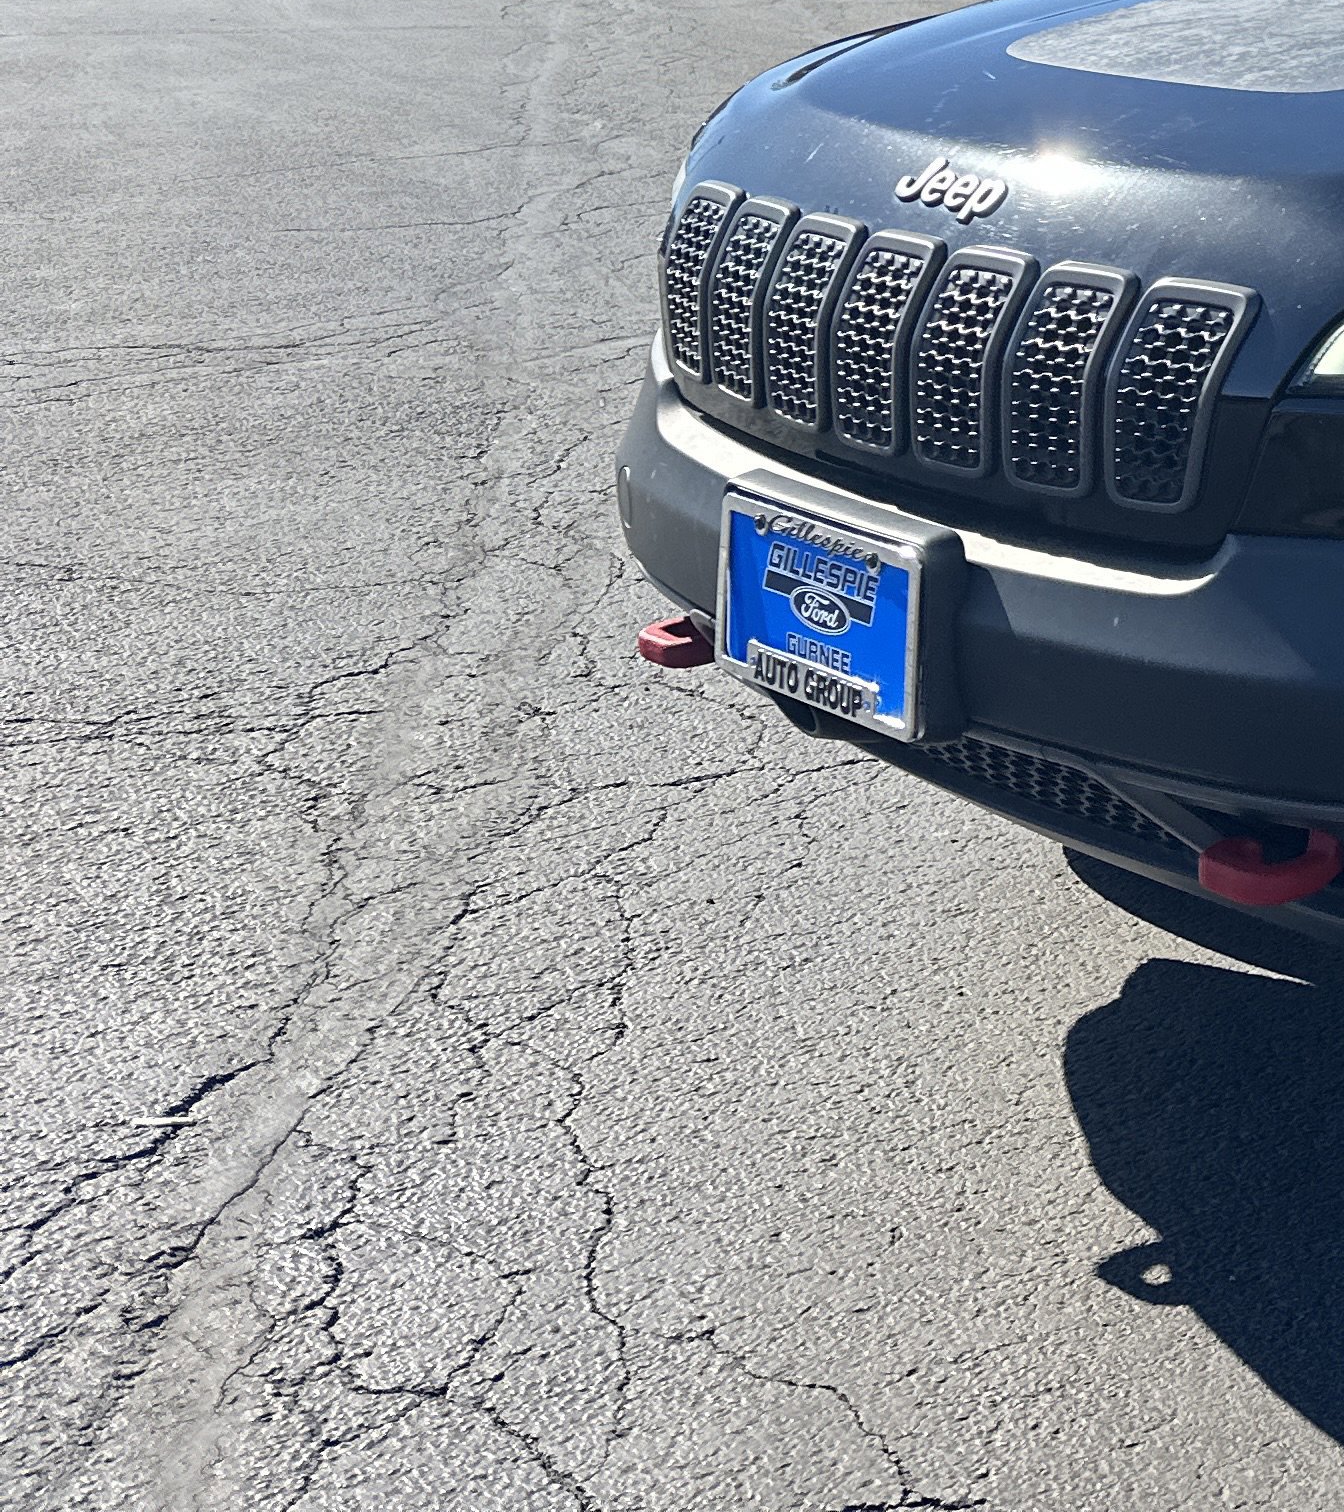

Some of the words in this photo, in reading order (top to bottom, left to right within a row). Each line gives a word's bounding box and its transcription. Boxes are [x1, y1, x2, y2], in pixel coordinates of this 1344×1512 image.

[894, 156, 1009, 226] Jeep
[768, 514, 873, 561] Gillespie
[768, 541, 880, 603] GILLESPIE
[799, 593, 840, 630] Ford
[786, 632, 851, 674] GURNEE
[753, 649, 798, 694] AUTO
[804, 668, 863, 718] GROUP
